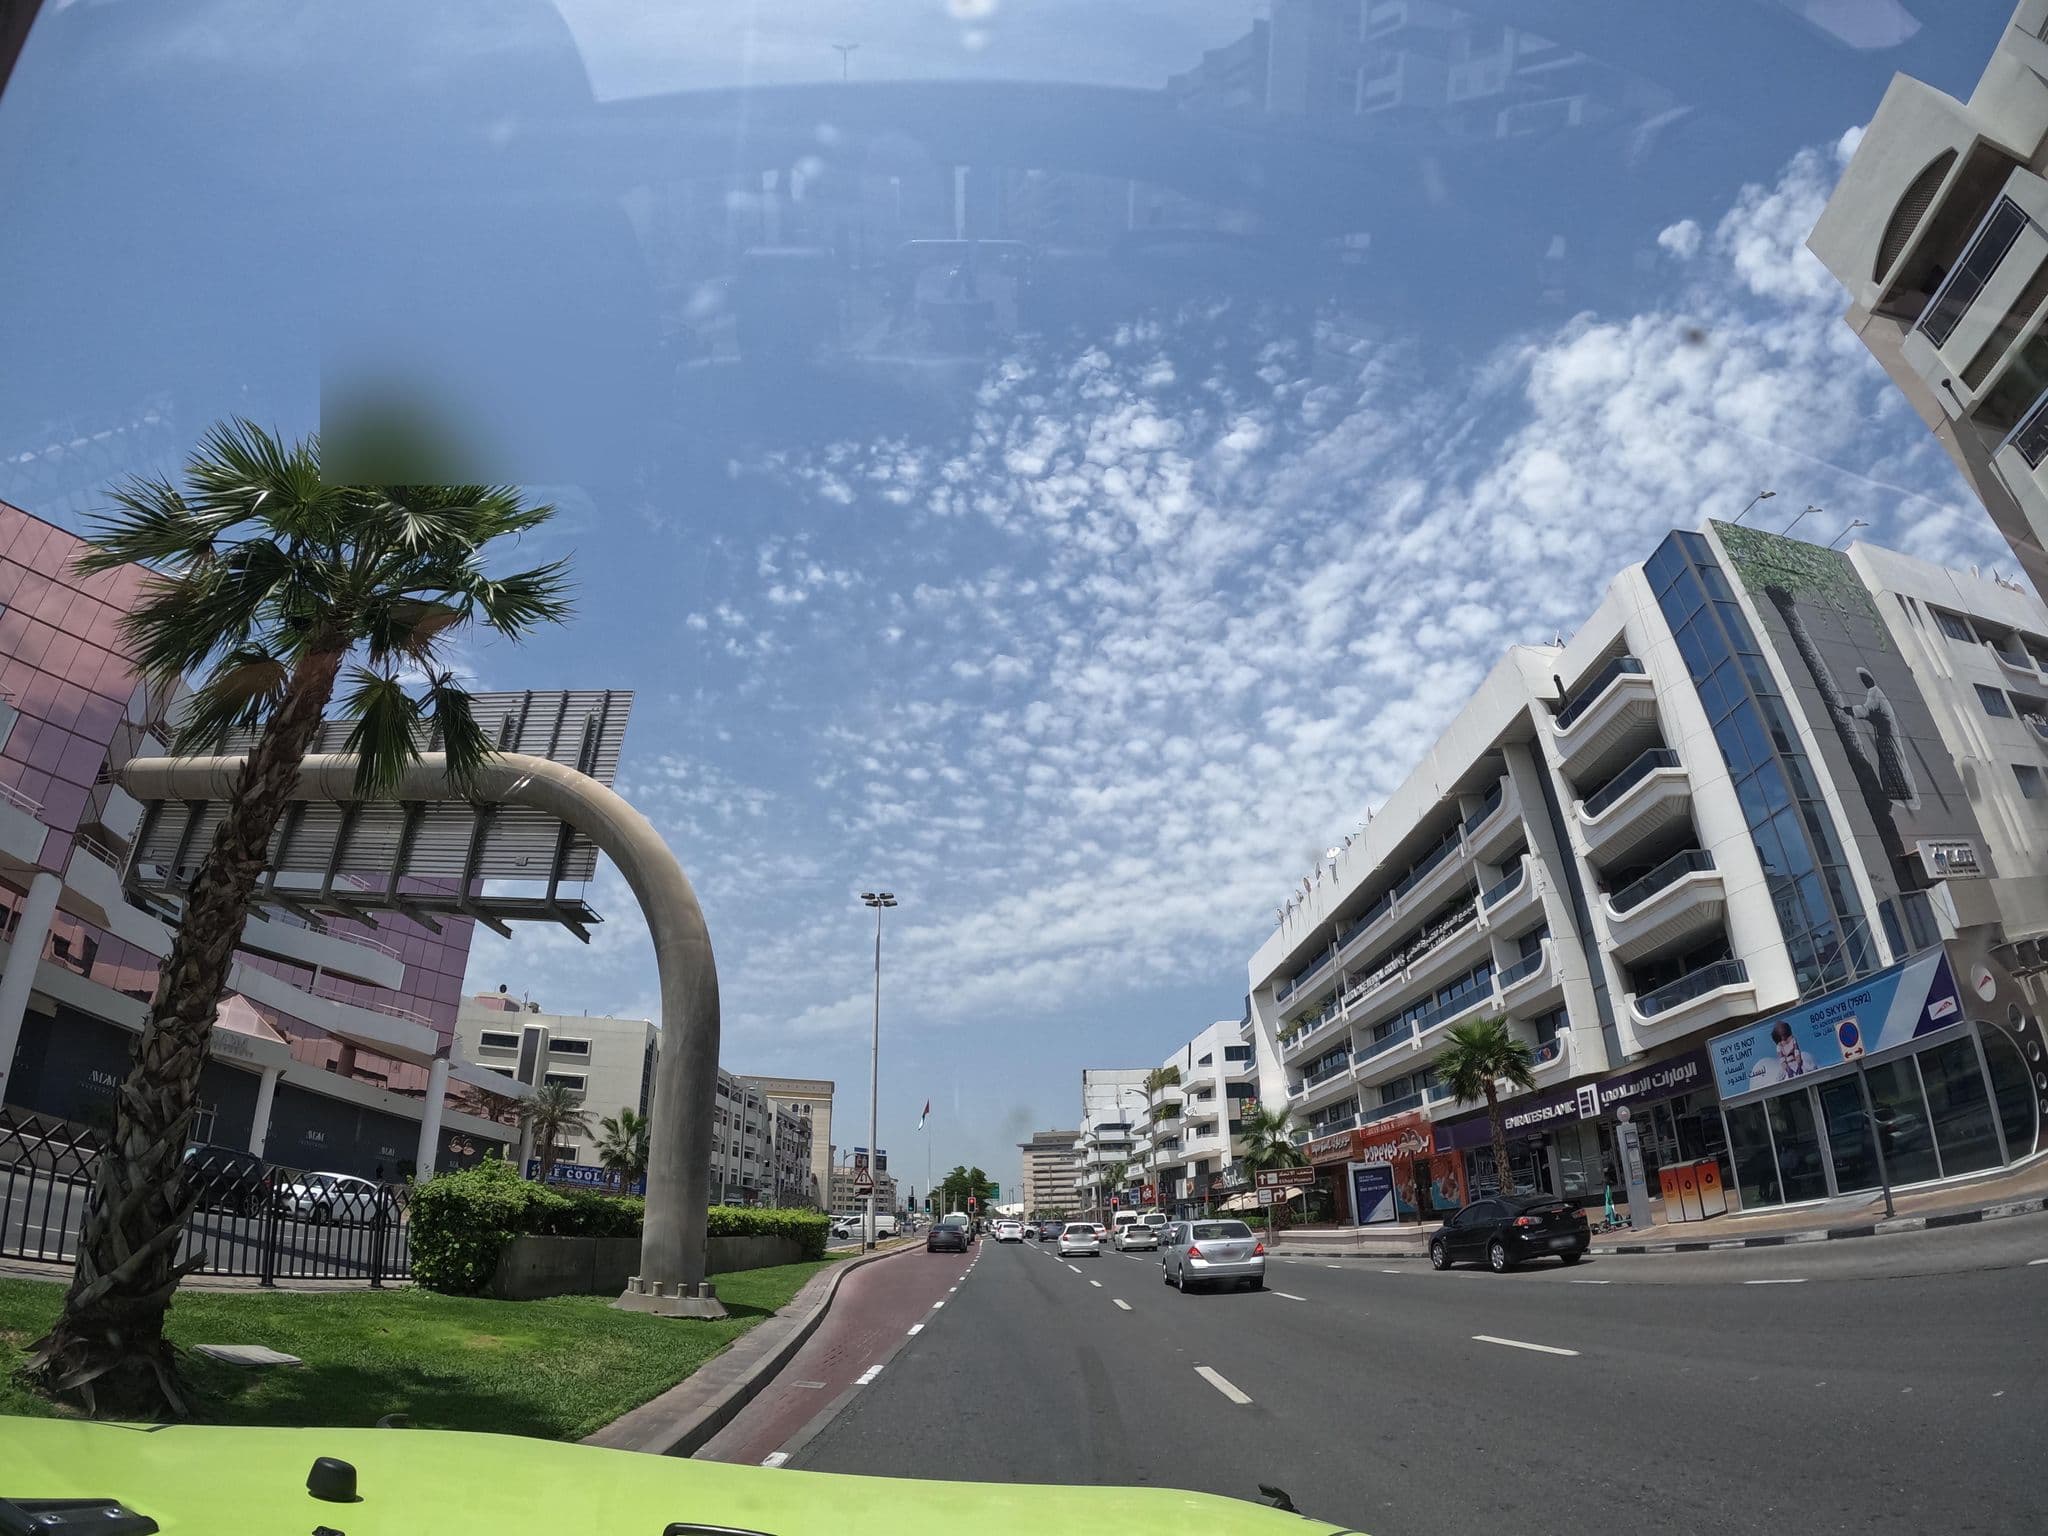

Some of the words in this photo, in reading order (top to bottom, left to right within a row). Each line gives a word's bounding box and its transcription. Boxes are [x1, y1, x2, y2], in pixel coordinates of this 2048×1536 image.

[1810, 1010, 1825, 1023] 800
[1826, 1002, 1847, 1017] SKYB
[1848, 990, 1872, 1009] (7592)
[1720, 1044, 1733, 1055] SKY
[1734, 1042, 1741, 1051] IS
[1741, 1037, 1755, 1048] NOT
[1722, 1055, 1735, 1064] THE
[1735, 1047, 1753, 1060] LIMIT
[1652, 1061, 1697, 1088] الإمارات
[1725, 1062, 1745, 1075] السماء
[1748, 1065, 1766, 1078] ليست
[1727, 1071, 1747, 1086] الحدود
[1600, 1076, 1651, 1107] الإسلامي
[1504, 1109, 1542, 1129] EMIRATES
[1542, 1100, 1576, 1120] ISLAMIC
[566, 1169, 600, 1181] COOL
